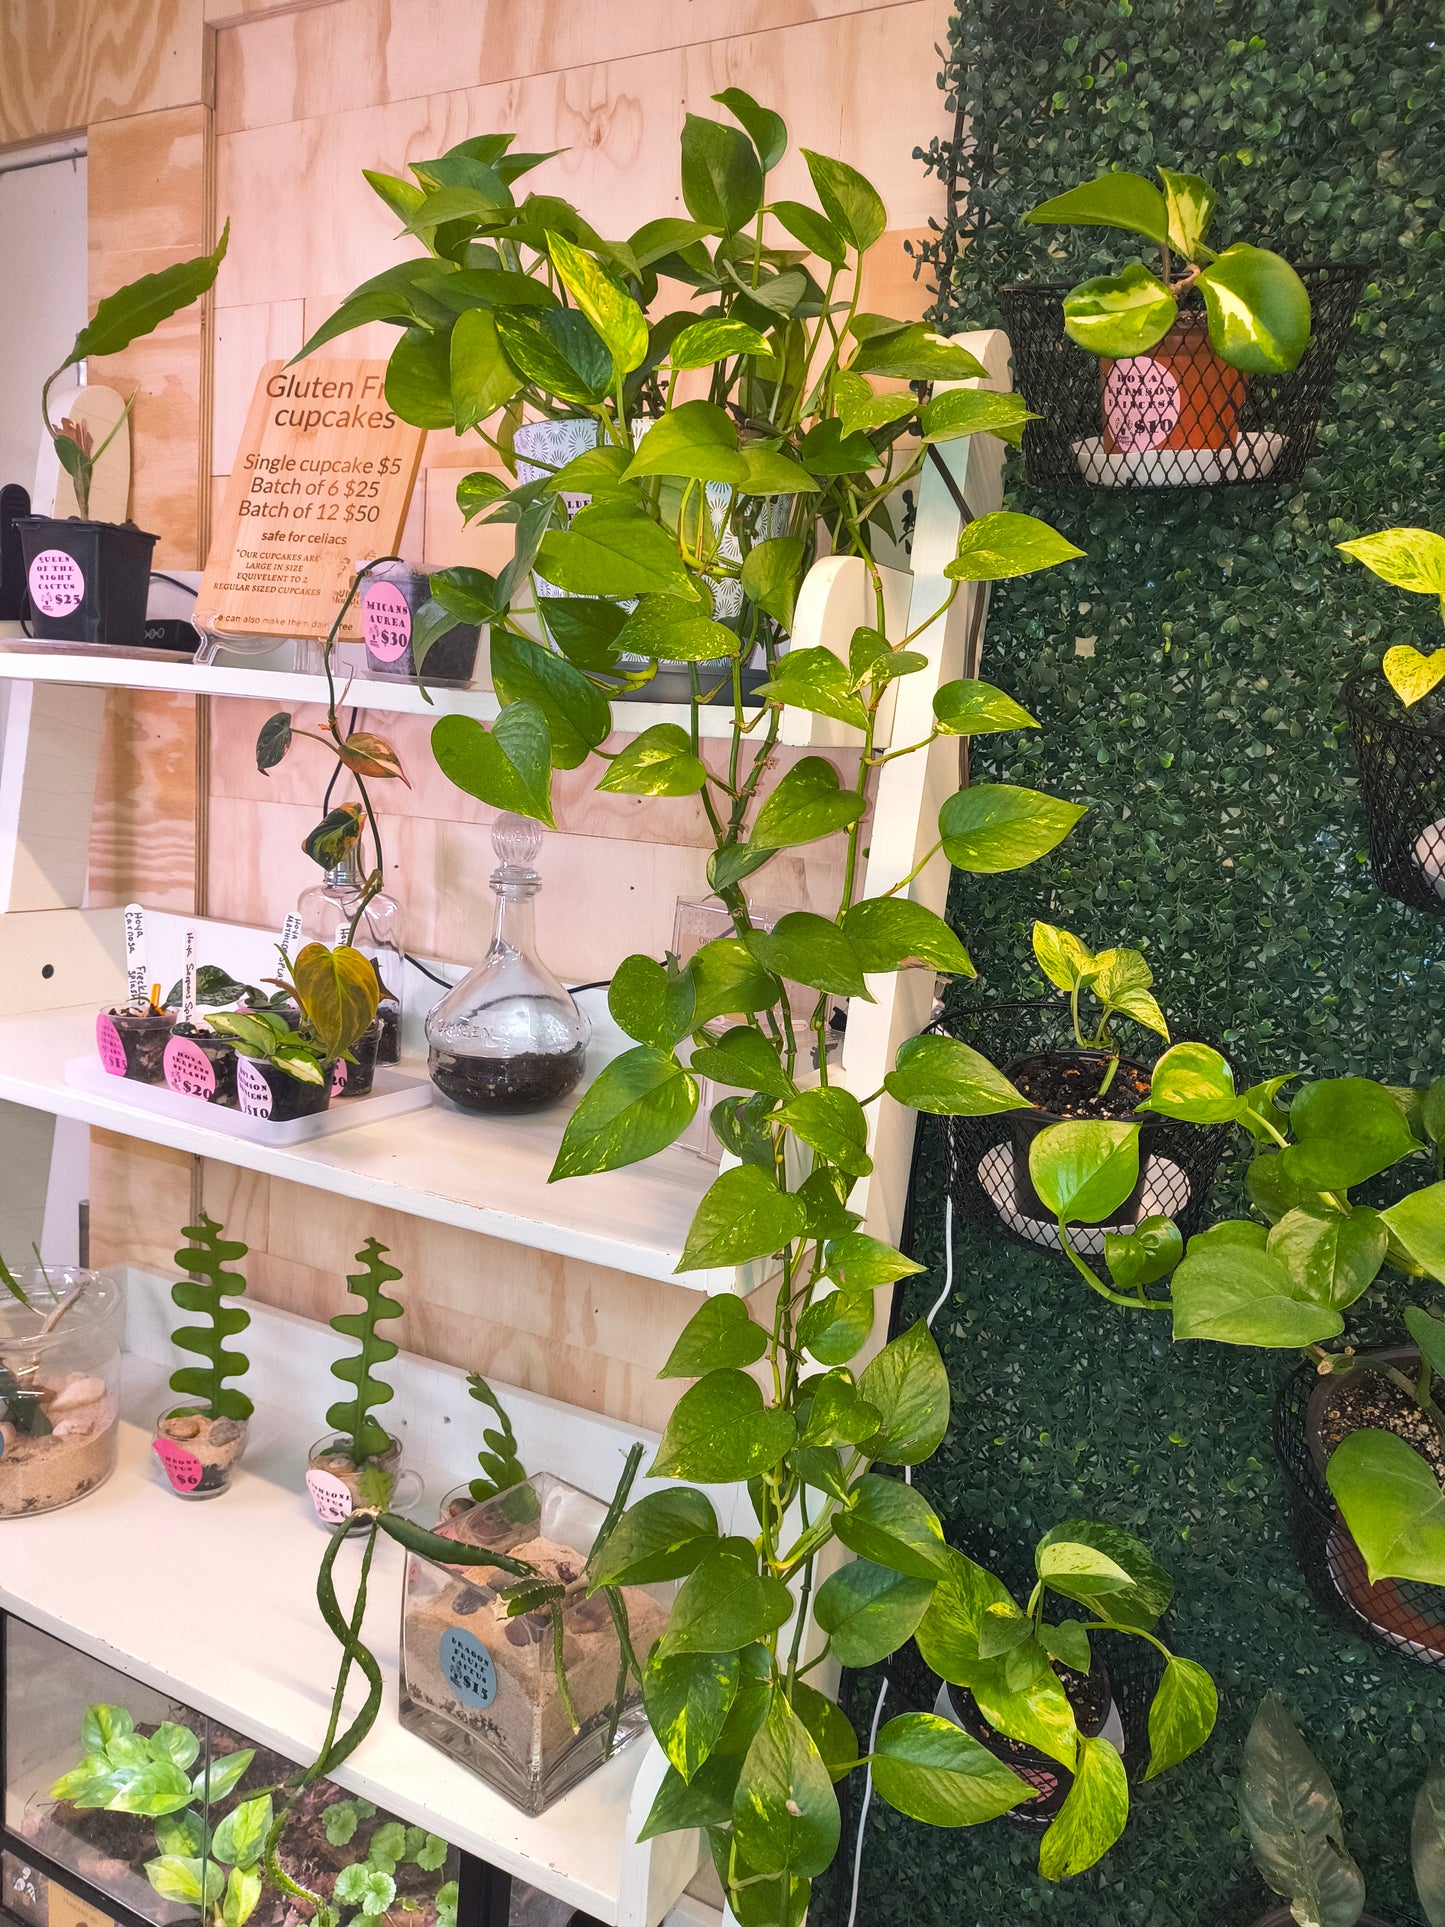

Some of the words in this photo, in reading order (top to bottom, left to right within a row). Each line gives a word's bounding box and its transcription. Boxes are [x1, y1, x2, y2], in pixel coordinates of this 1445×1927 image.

[266, 374, 354, 399] Gluten
[361, 376, 385, 399] Fr
[275, 404, 396, 432] cupcakes
[1134, 418, 1173, 436] $10
[243, 454, 296, 474] Single
[300, 457, 373, 475] cupcake
[377, 456, 402, 476] $5
[251, 477, 301, 494] Batch
[305, 479, 326, 495] of
[327, 480, 339, 496] 6
[343, 479, 380, 498] $25
[238, 500, 289, 518] Batch
[293, 503, 314, 519] of
[316, 503, 340, 520] 12
[343, 503, 380, 523] $50
[261, 530, 286, 542] safe
[288, 531, 306, 543] for
[307, 533, 348, 545] celiacs
[259, 552, 302, 561] CUPCAKES
[245, 562, 272, 570] LARGE
[273, 563, 283, 571] IN
[284, 564, 304, 572] SIZE
[302, 576, 308, 584] 2
[213, 583, 250, 592] REGULAR
[251, 585, 277, 594] SIZED
[277, 586, 321, 596] CUPCAKES
[54, 593, 81, 606] $25
[366, 601, 408, 615] MICANS
[225, 615, 240, 623] can
[243, 615, 260, 624] also
[262, 617, 286, 626] make
[288, 619, 310, 627] them
[311, 621, 329, 629] dair
[338, 623, 354, 631] ree
[368, 615, 406, 628] AUREA
[380, 629, 408, 647] $30
[338, 928, 350, 945] Hoy
[177, 1051, 203, 1065] HOYA
[173, 1064, 207, 1082] SPLASH
[182, 1080, 213, 1100] $20
[247, 1104, 269, 1119] $10
[176, 1474, 198, 1485] $6
[451, 1637, 489, 1667] DRAGON
[454, 1648, 486, 1673] FRUIT
[451, 1655, 487, 1684] CACTUS
[463, 1675, 488, 1700] $15
